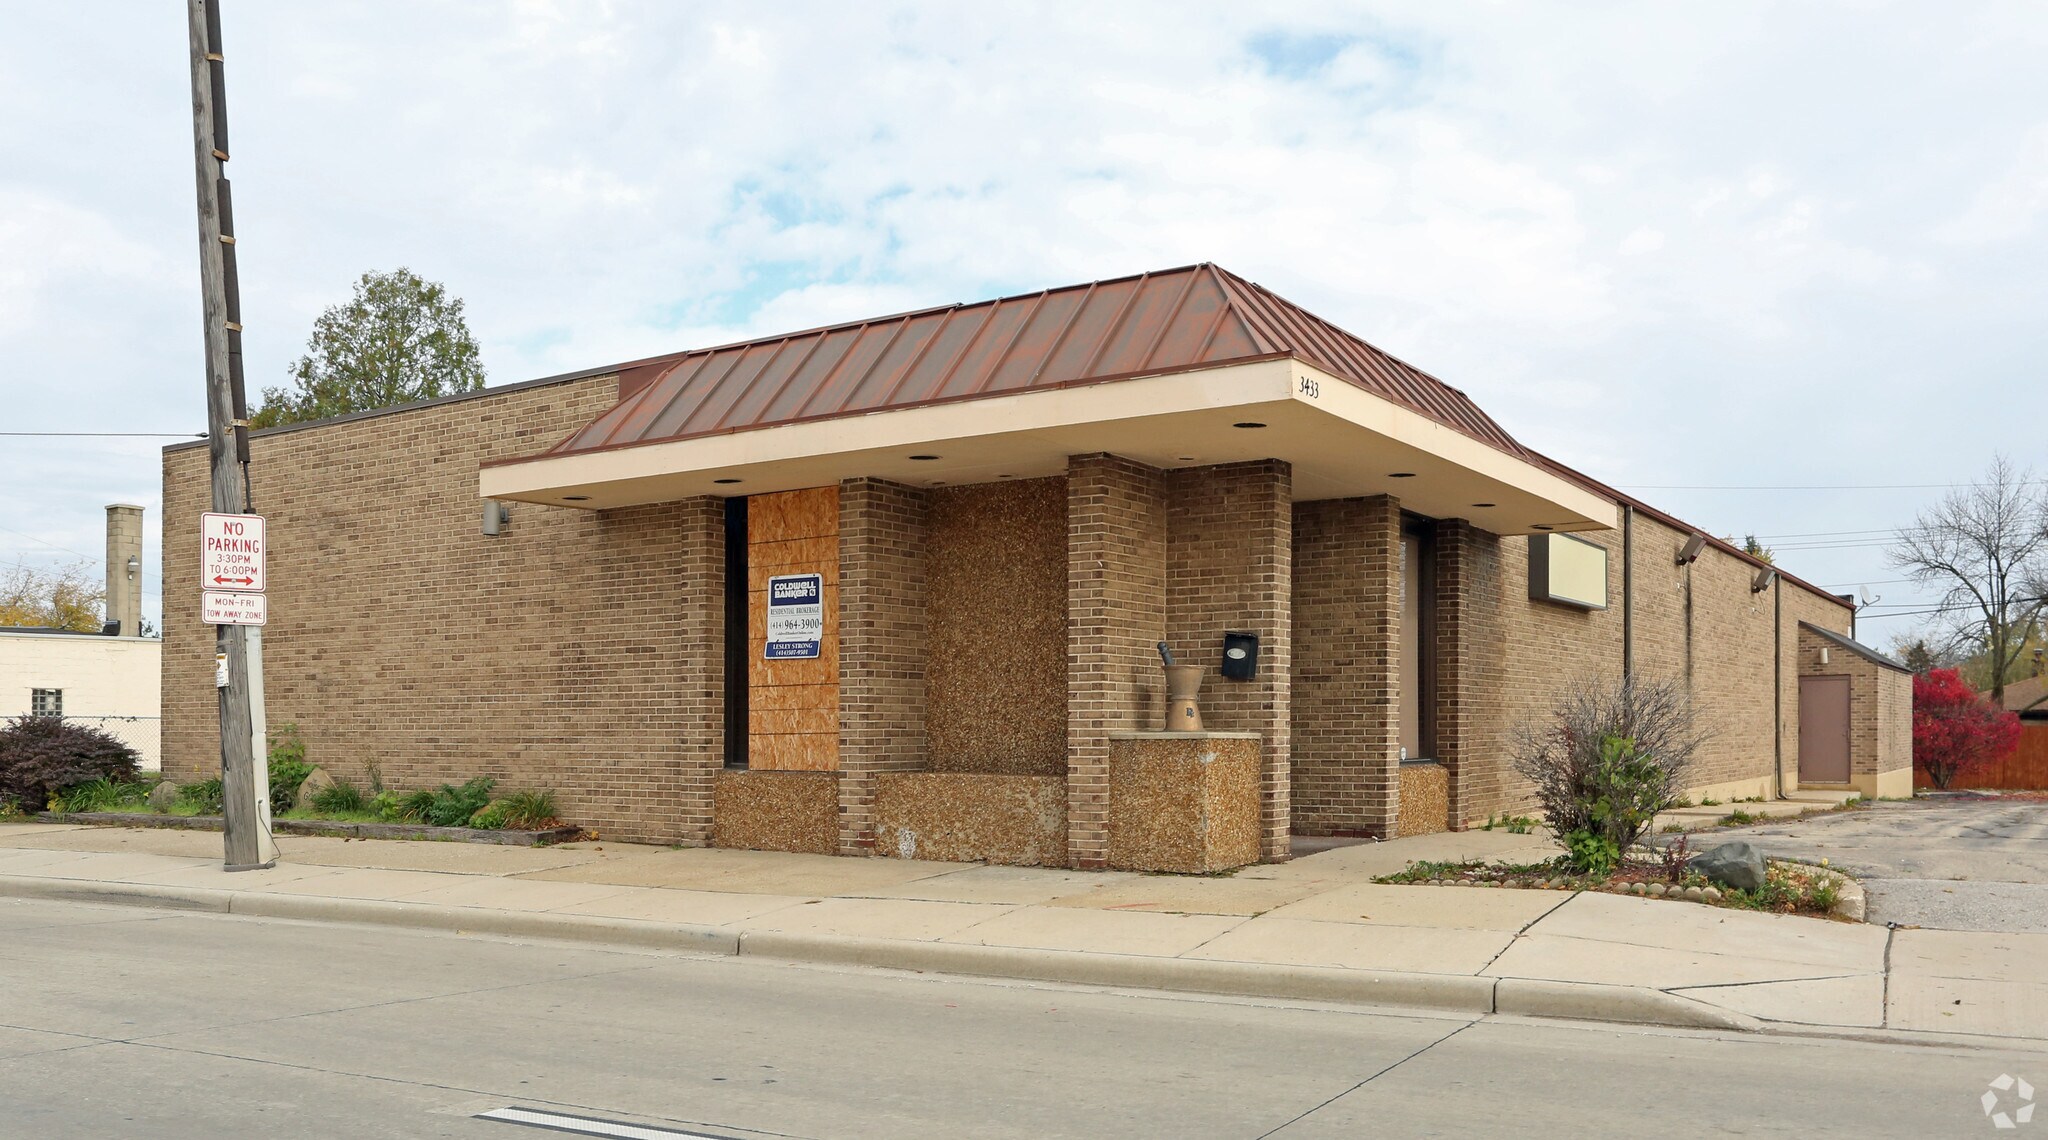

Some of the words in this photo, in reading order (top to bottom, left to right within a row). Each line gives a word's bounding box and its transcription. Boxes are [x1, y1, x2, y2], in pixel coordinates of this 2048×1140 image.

[1299, 376, 1319, 399] 3433
[224, 521, 244, 536] NO
[208, 537, 260, 553] PARKING
[217, 554, 251, 564] 3:30PM
[210, 564, 221, 574] TO
[223, 565, 258, 575] 6:00PM
[215, 598, 255, 607] MON-FRI
[207, 609, 221, 618] TOW
[223, 610, 242, 619] AWAY
[245, 611, 262, 620] ZONE
[770, 607, 795, 615] RESIDENTIAL
[796, 606, 819, 614] BROKERAGE
[770, 621, 784, 630] (414)
[784, 618, 820, 630] 964-3900
